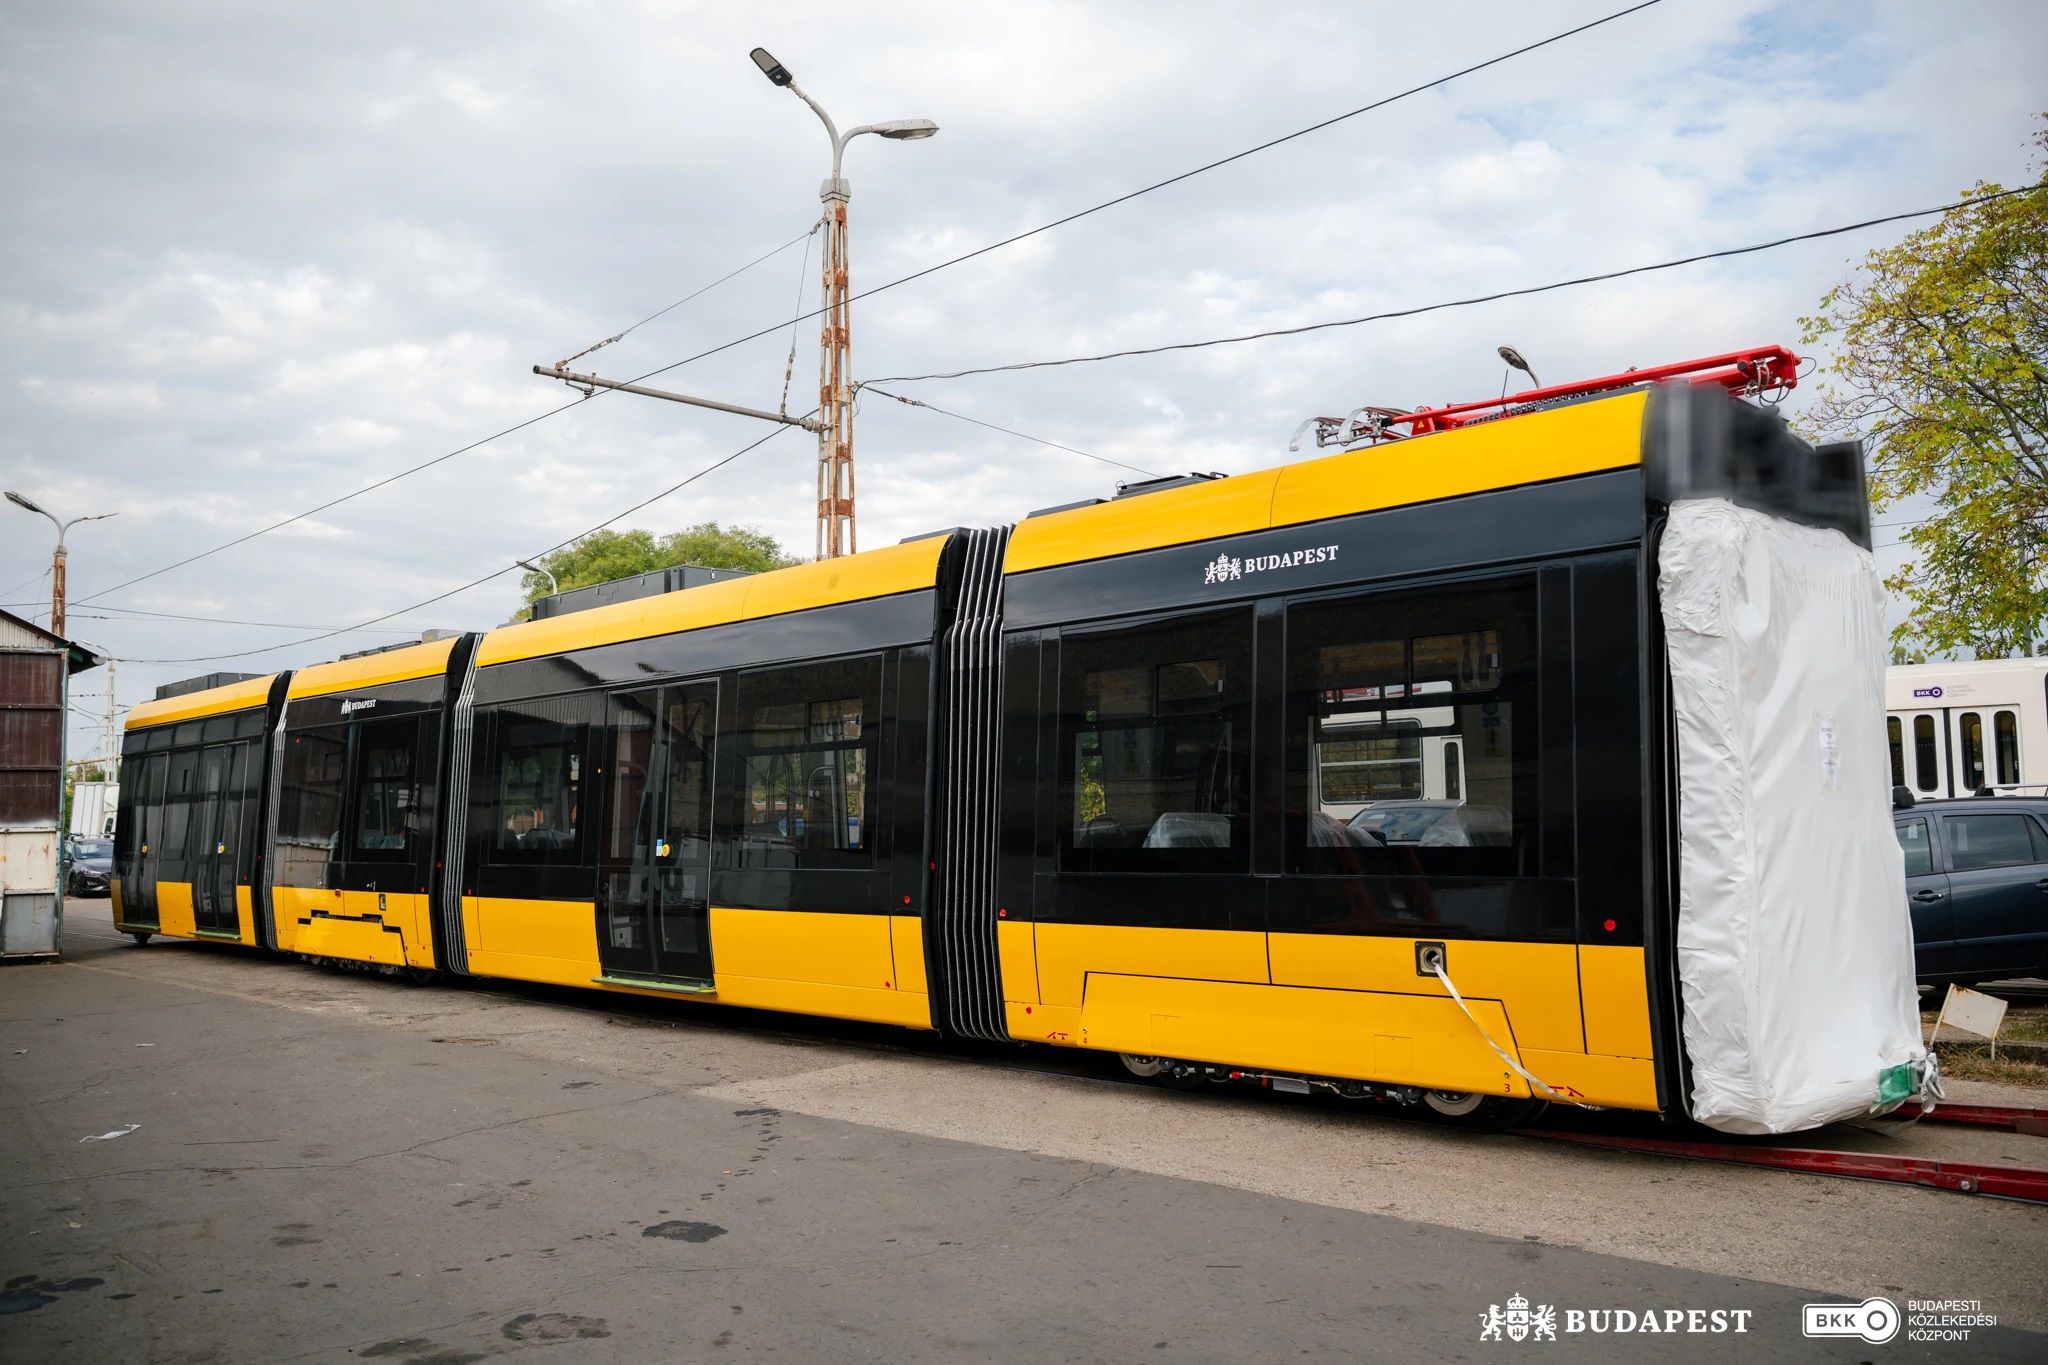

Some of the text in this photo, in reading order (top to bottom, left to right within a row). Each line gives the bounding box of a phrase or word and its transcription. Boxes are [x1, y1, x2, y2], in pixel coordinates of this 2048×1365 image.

[1244, 545, 1339, 573] BUDAPEST
[351, 699, 377, 710] BUDAPEST
[1504, 1083, 1511, 1093] 3
